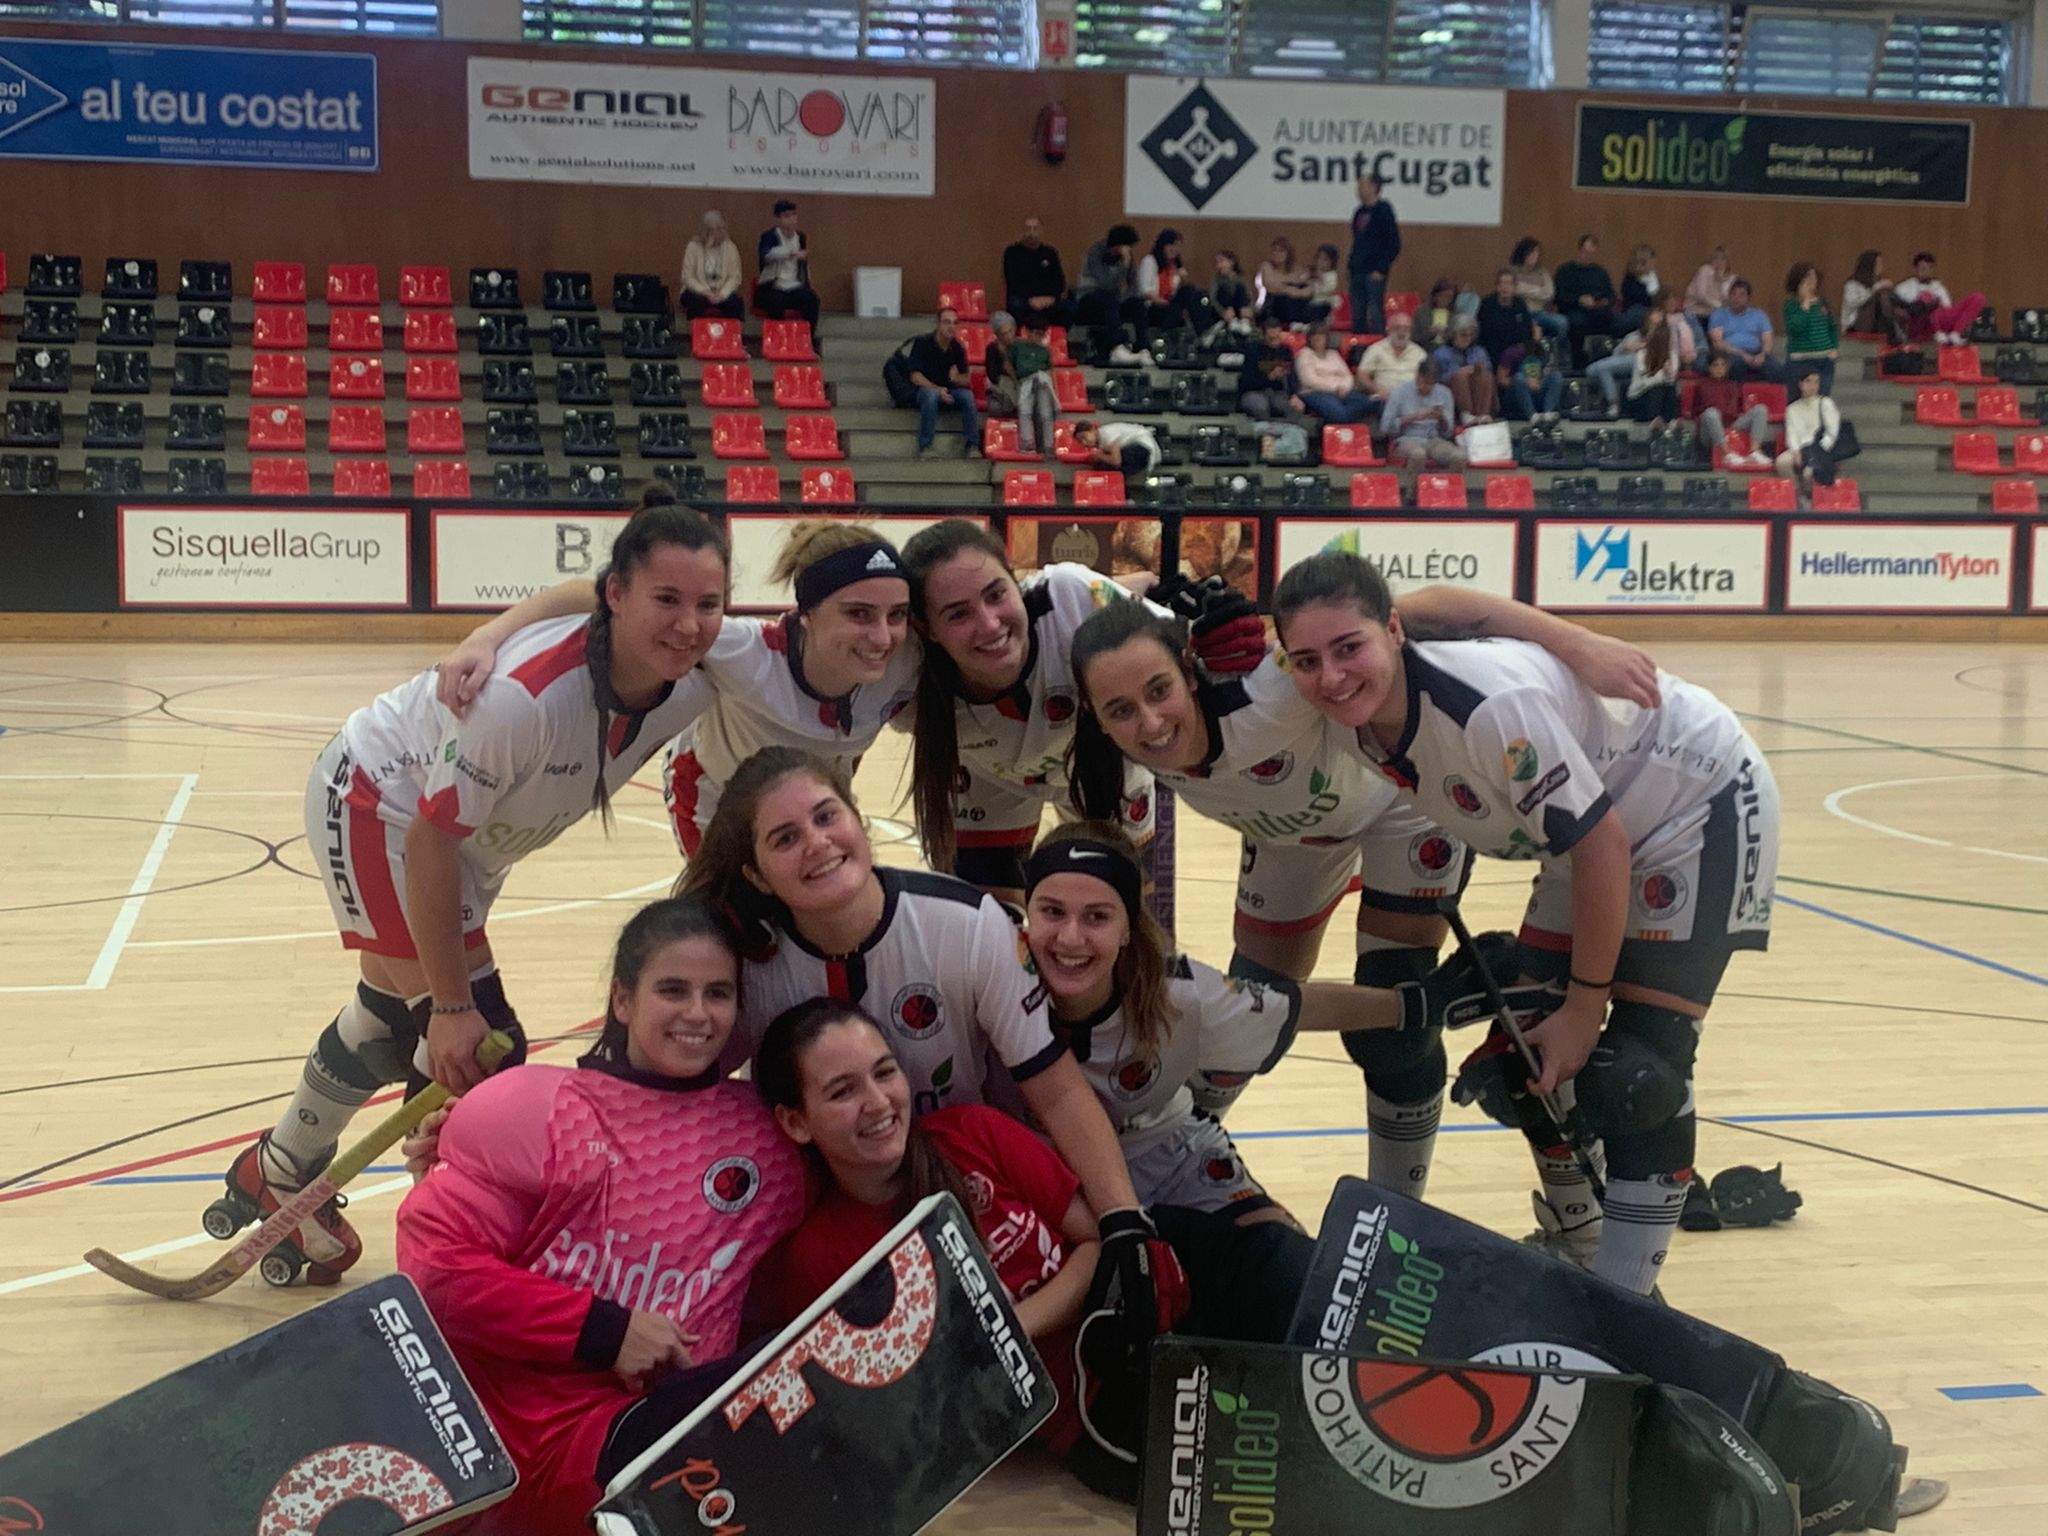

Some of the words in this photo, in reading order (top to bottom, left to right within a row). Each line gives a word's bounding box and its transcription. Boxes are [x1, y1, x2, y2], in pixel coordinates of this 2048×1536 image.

[81, 79, 121, 121] al
[133, 82, 207, 125] teu
[218, 88, 362, 131] costat
[1273, 117, 1452, 148] AJUNTAMENT
[1459, 123, 1492, 149] DE
[1602, 118, 1729, 184] solideo
[732, 164, 921, 181] www.barovari.com
[1272, 146, 1492, 196] SantCugat
[152, 526, 381, 565] SisquellaGrup
[1620, 540, 1735, 591] elektra
[1800, 551, 2000, 582] HellermannTyton
[1361, 1206, 1390, 1279] HOCKEY
[368, 1307, 428, 1406] AUTHENTIC
[424, 1405, 470, 1481] HOCKEY
[1490, 1403, 1568, 1489] SANT
